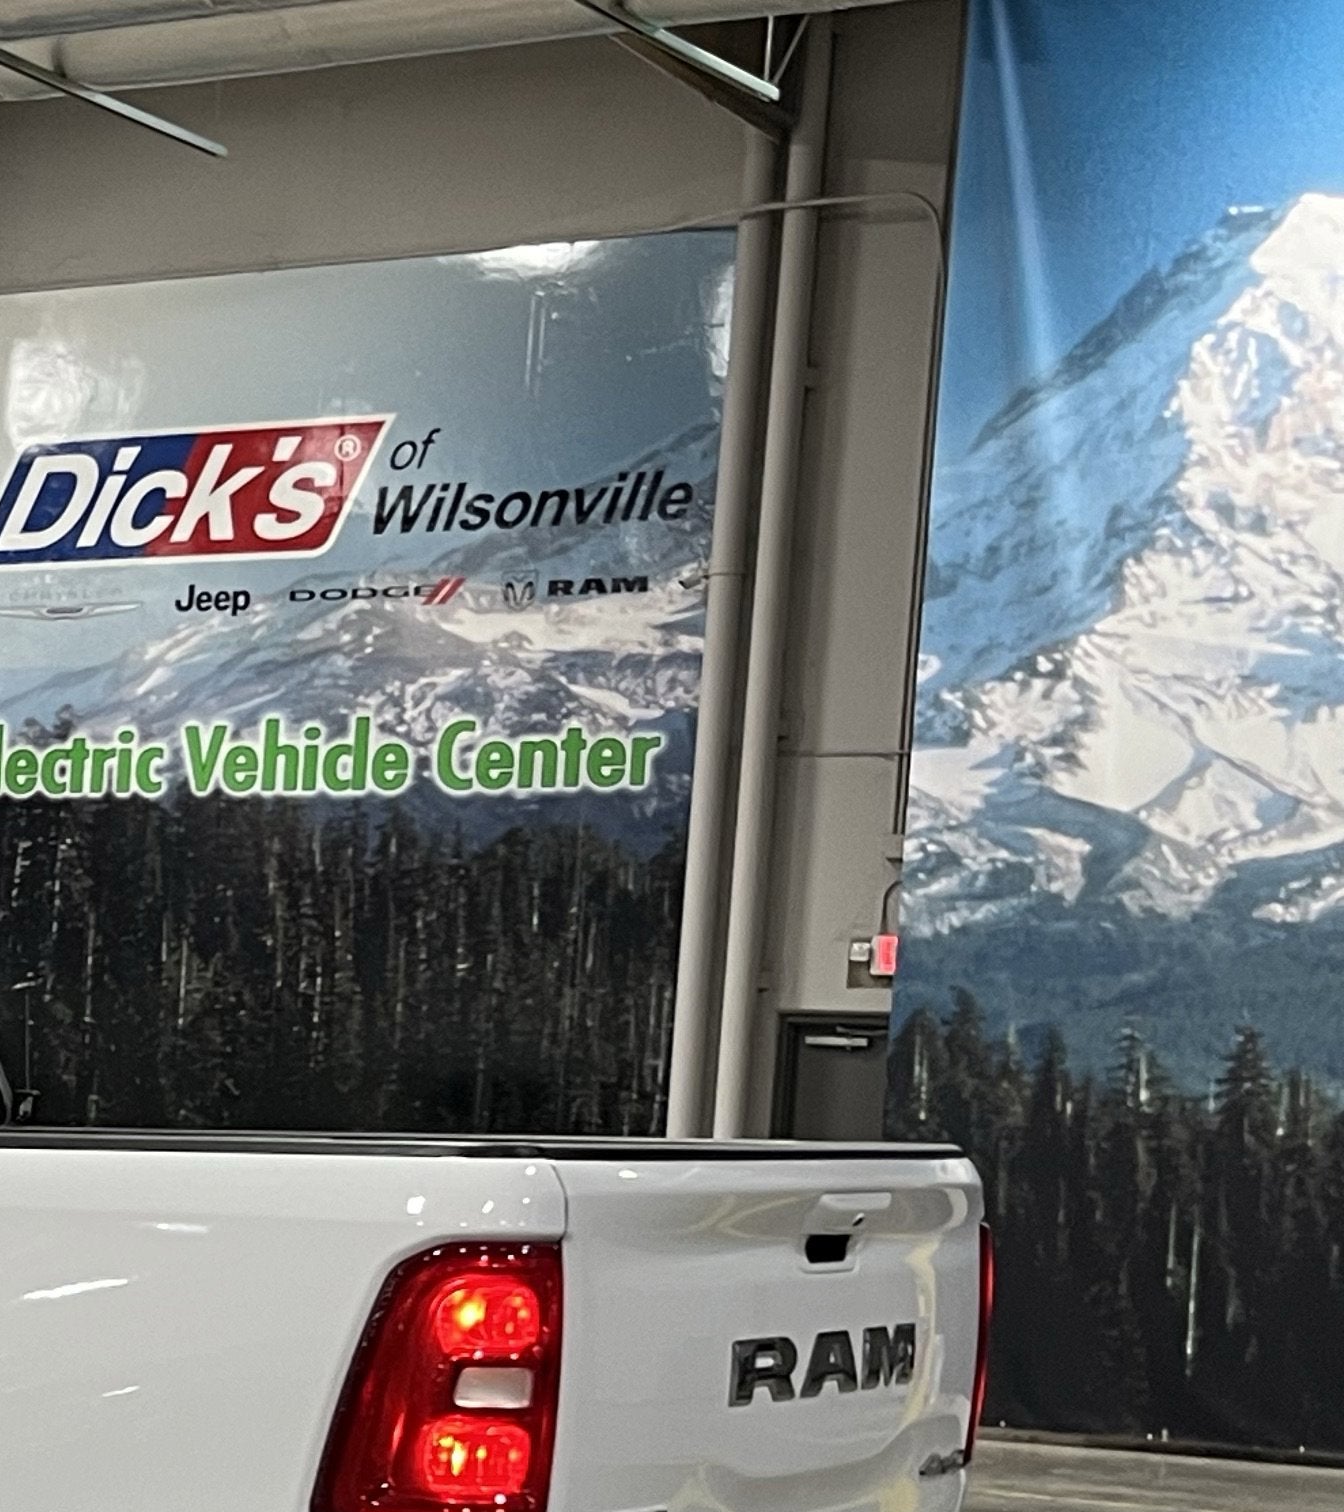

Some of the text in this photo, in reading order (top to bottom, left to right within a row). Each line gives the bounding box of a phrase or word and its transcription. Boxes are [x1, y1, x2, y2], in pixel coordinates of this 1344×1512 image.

[390, 428, 442, 471] of
[372, 470, 693, 536] Wilsonville
[174, 584, 251, 616] Jeep
[289, 584, 432, 601] DODGE
[548, 576, 649, 597] RAM
[183, 717, 409, 792] Vehicle
[436, 719, 662, 791] Center
[728, 1322, 916, 1408] RAM
